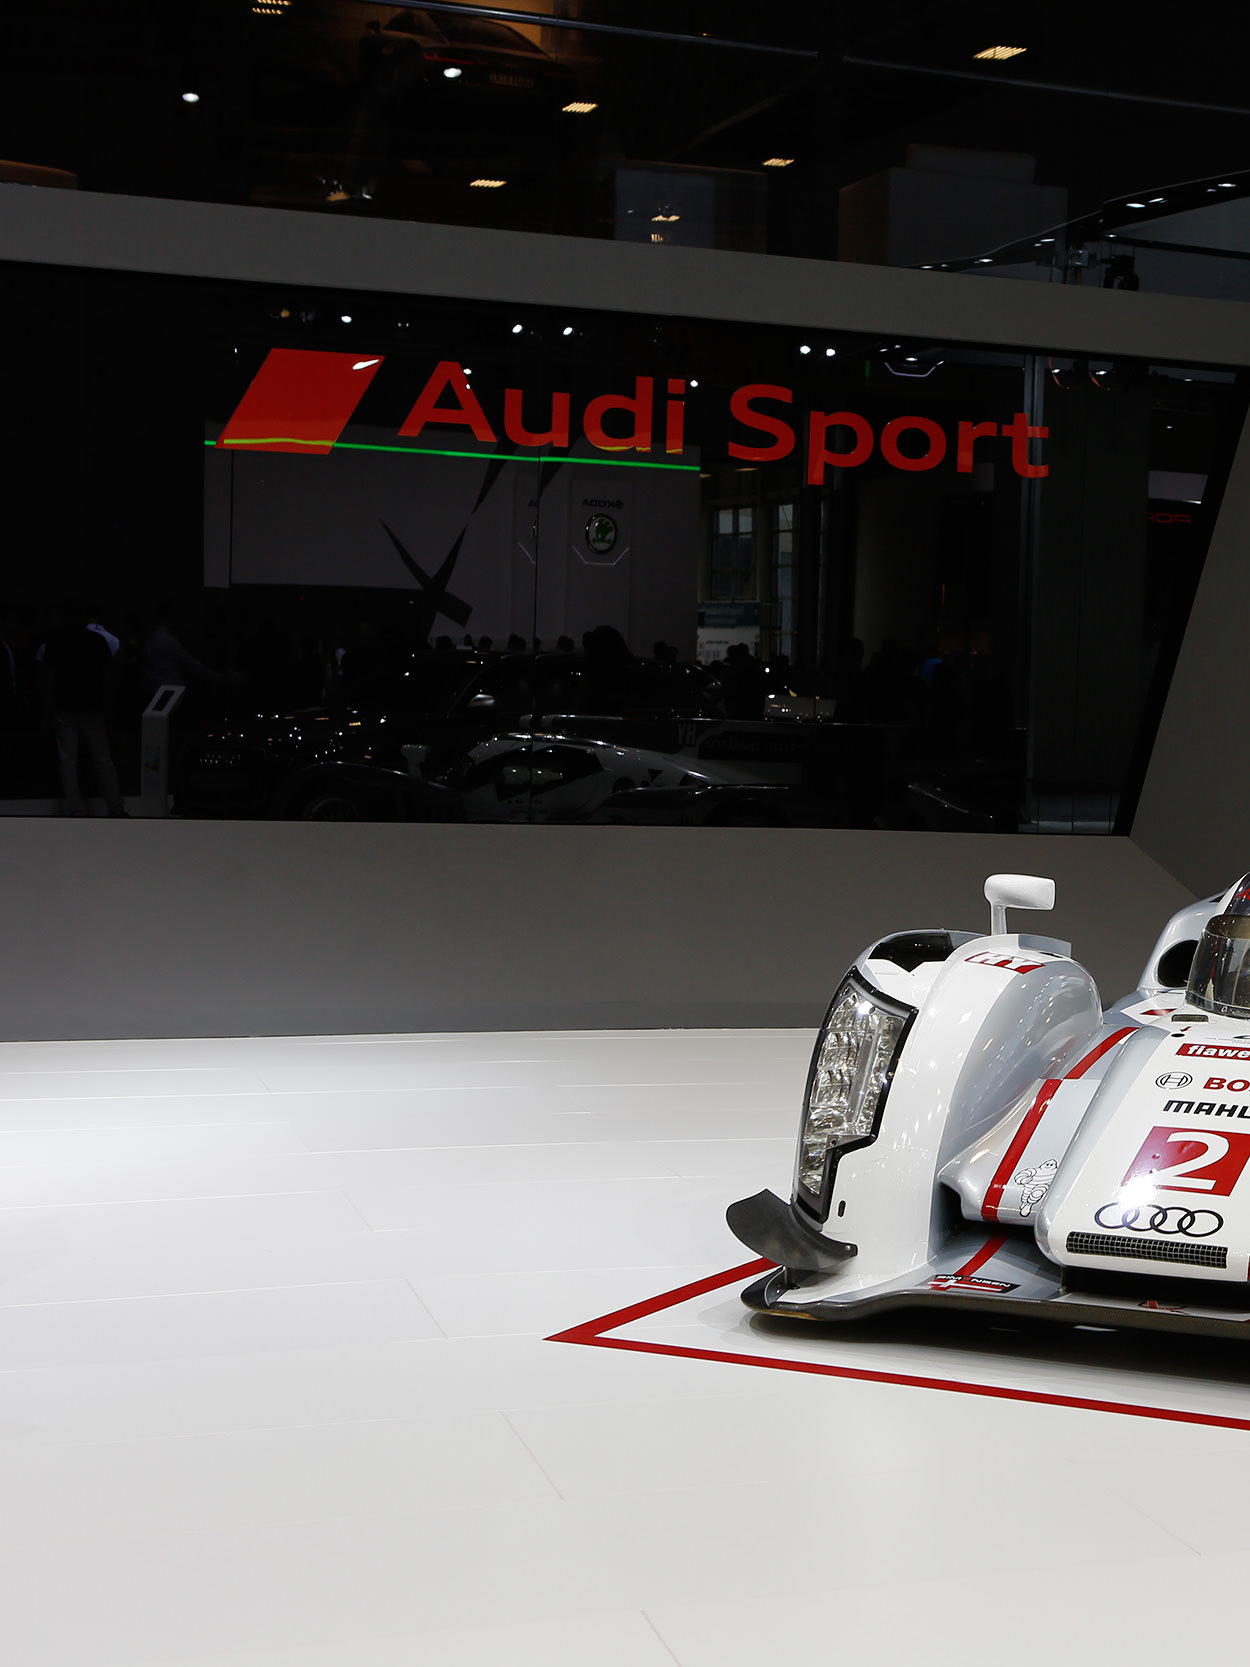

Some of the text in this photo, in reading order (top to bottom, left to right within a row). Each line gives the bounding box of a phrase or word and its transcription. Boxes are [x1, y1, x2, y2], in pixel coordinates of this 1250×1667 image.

[397, 360, 1049, 486] Audi Sport
[1152, 1130, 1231, 1191] 2
